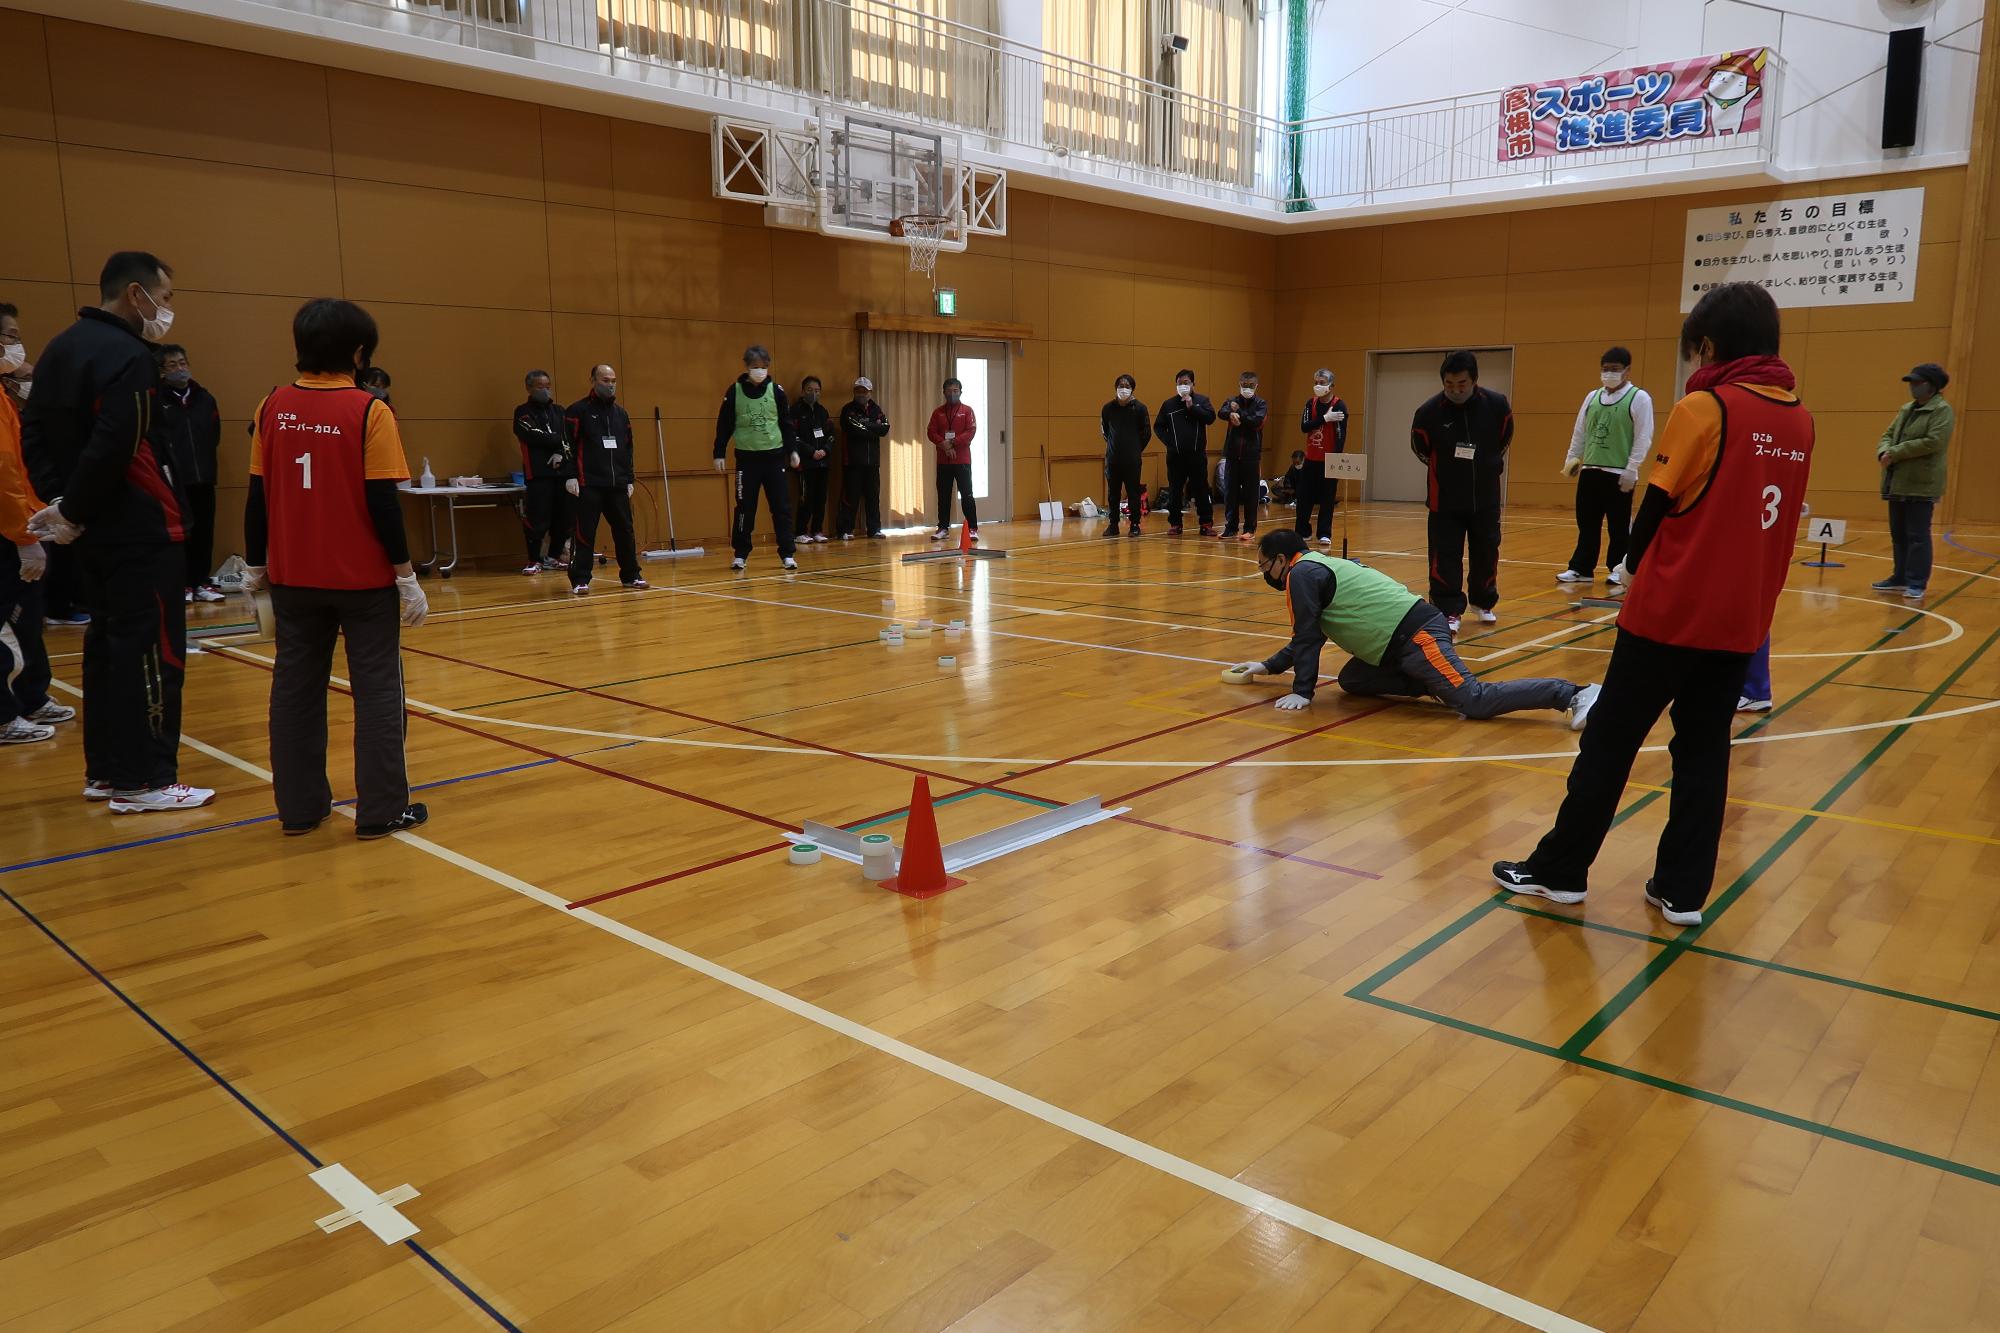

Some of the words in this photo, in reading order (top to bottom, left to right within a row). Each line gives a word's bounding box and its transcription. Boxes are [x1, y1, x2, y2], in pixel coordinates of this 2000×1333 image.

[1534, 73, 1673, 119] スポーツ
[1504, 87, 1534, 159] 彦根市
[1556, 99, 1707, 151] 推進委員
[1727, 199, 1875, 226] 私たちの目標
[277, 413, 297, 421] ひこね
[279, 421, 341, 435] スーパーカロム
[295, 452, 312, 489] 1
[1761, 485, 1782, 530] 3
[1819, 522, 1833, 538] A
